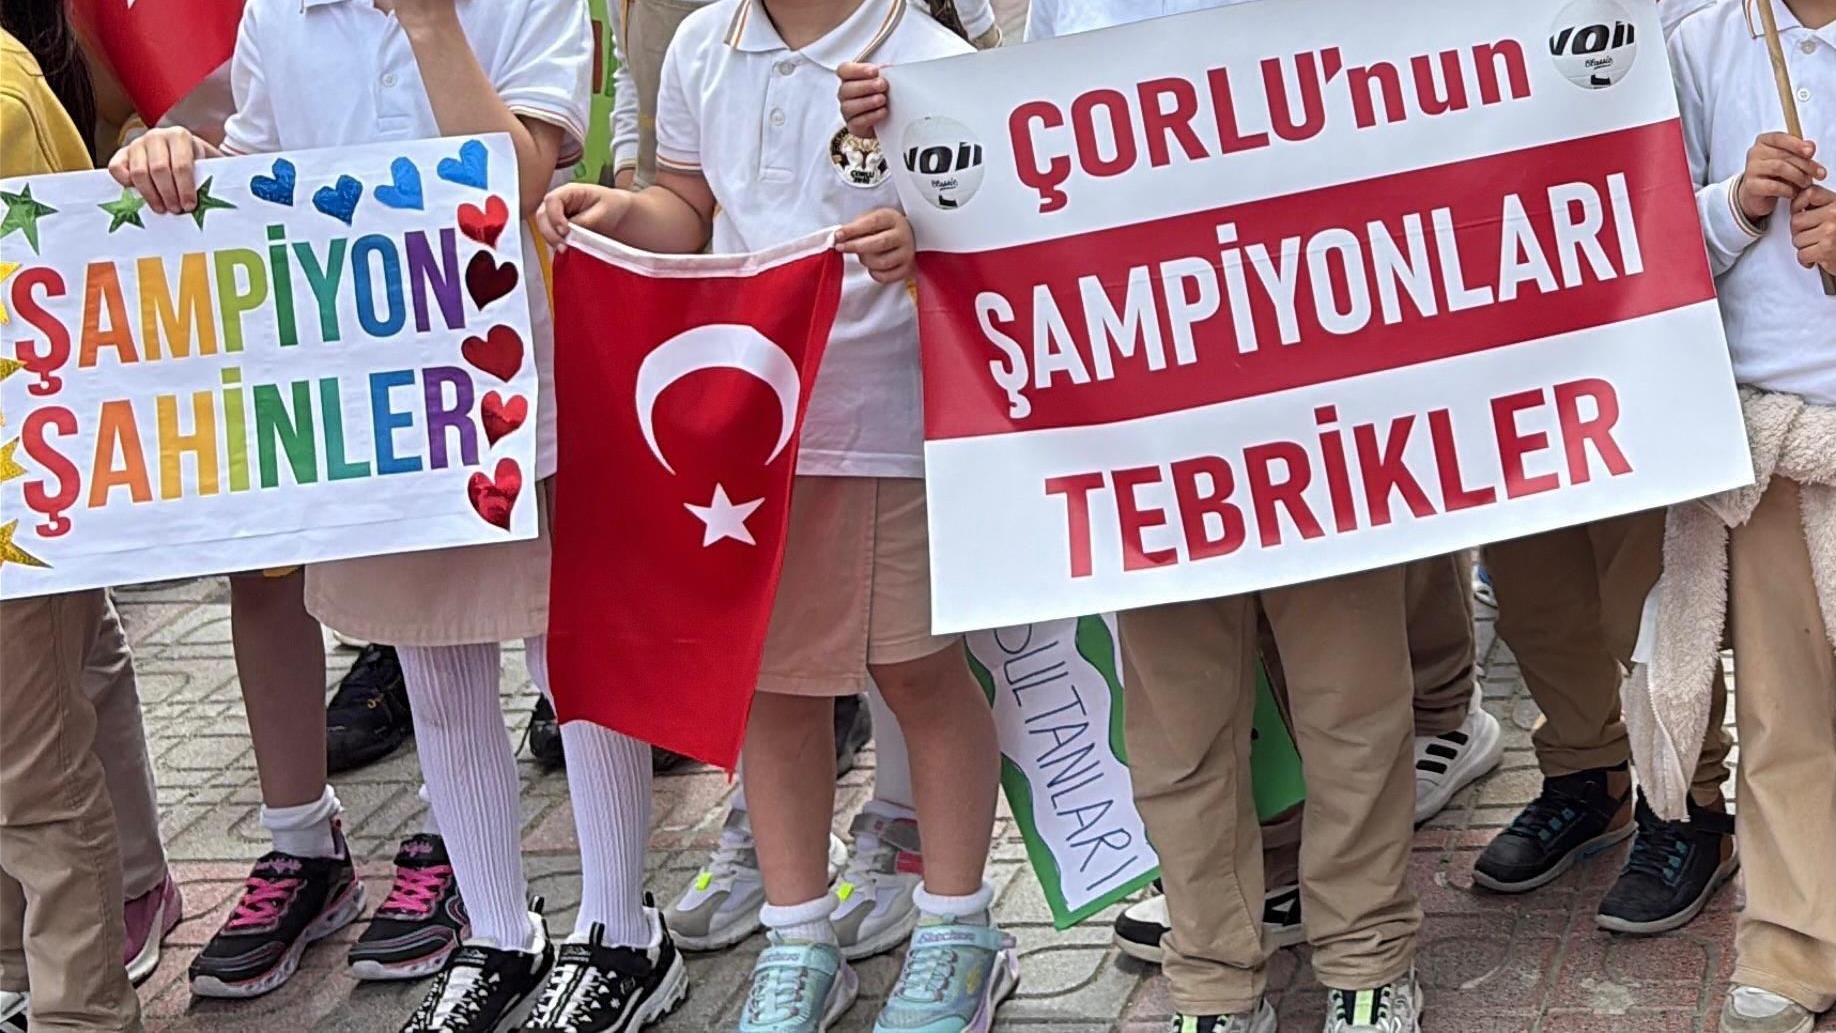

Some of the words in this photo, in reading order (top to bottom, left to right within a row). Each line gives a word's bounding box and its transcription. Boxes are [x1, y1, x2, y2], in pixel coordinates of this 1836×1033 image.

[1008, 38, 1532, 214] ÇORLU'nun
[11, 224, 466, 397] ŞAMPİYON
[975, 172, 1645, 419] ŞAMPİYONLARI
[22, 366, 480, 538] ŞAHİNLER
[1045, 377, 1632, 579] TEBRİKLER
